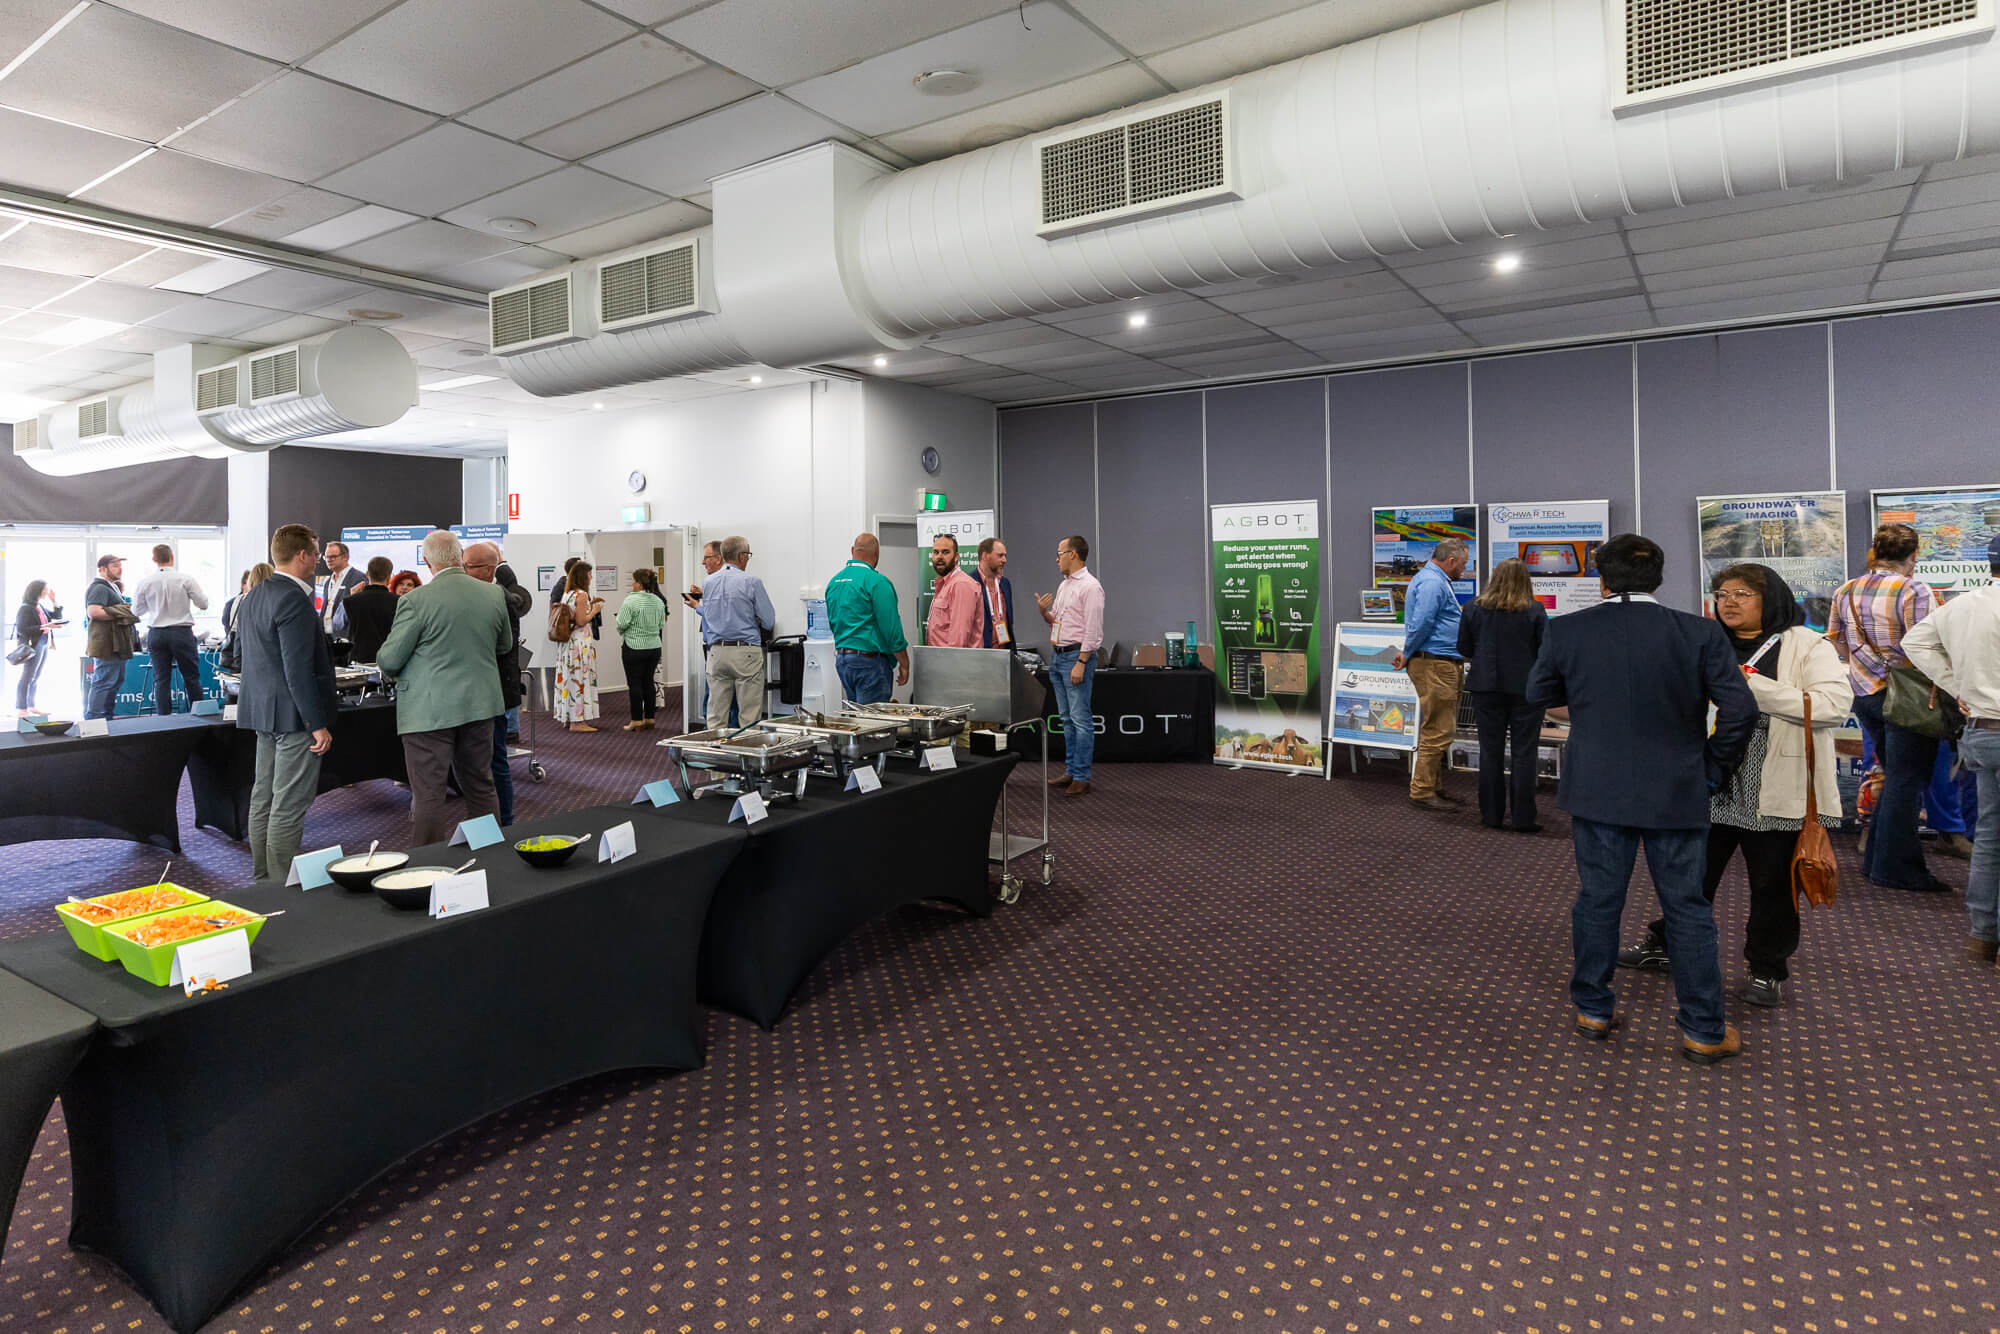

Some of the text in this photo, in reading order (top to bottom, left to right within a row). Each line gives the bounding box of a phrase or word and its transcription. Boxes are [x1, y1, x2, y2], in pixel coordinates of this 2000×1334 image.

[1745, 511, 1798, 520] IMAGING
[1223, 513, 1305, 528] AGBOT
[926, 522, 985, 535] AGBOT
[1290, 543, 1310, 552] runs,
[1236, 553, 1248, 562] get
[1225, 560, 1308, 570] something goes wrong!
[1915, 564, 1990, 574] ROUNDW
[1794, 579, 1839, 587] Recharge
